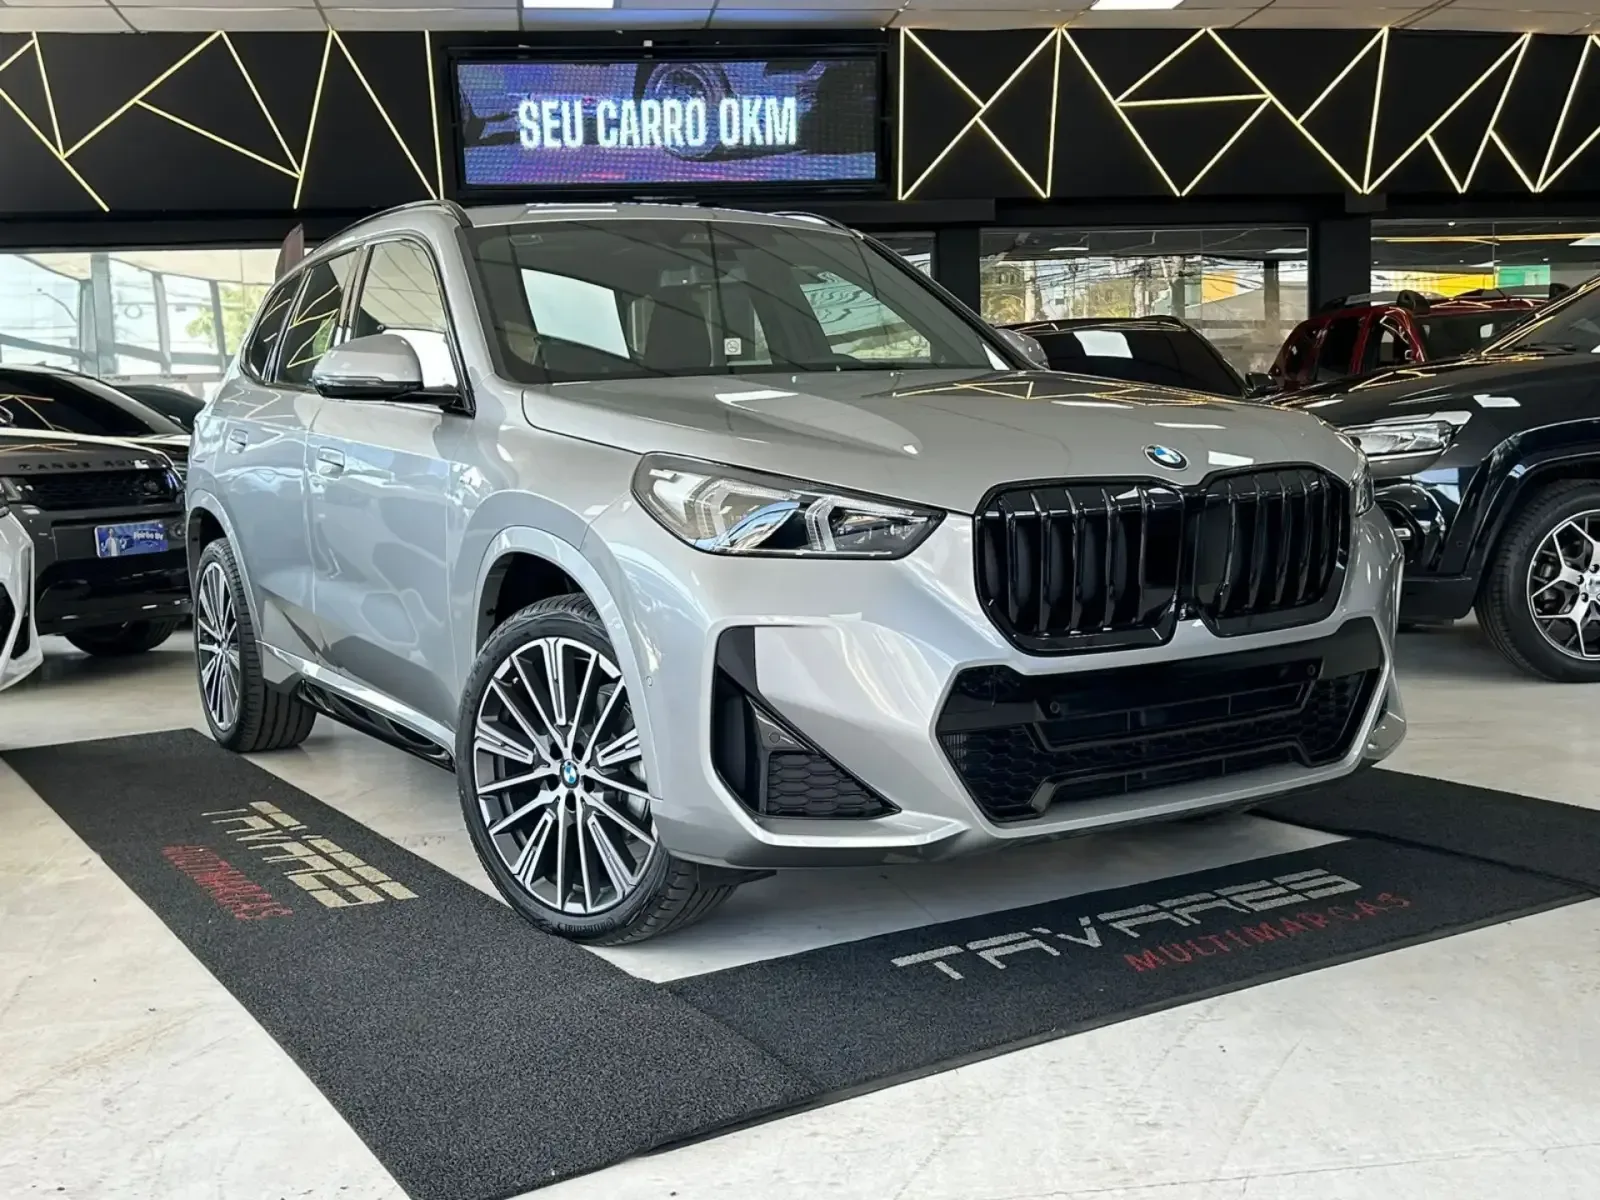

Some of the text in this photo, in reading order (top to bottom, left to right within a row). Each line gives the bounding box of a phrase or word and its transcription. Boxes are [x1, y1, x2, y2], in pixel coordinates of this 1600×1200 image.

[518, 99, 583, 148] SEU
[596, 97, 707, 148] CARRO
[201, 801, 419, 908] TAVARES
[890, 867, 1362, 981] TAVARES
[1123, 892, 1410, 973] MULTIMARCAS
